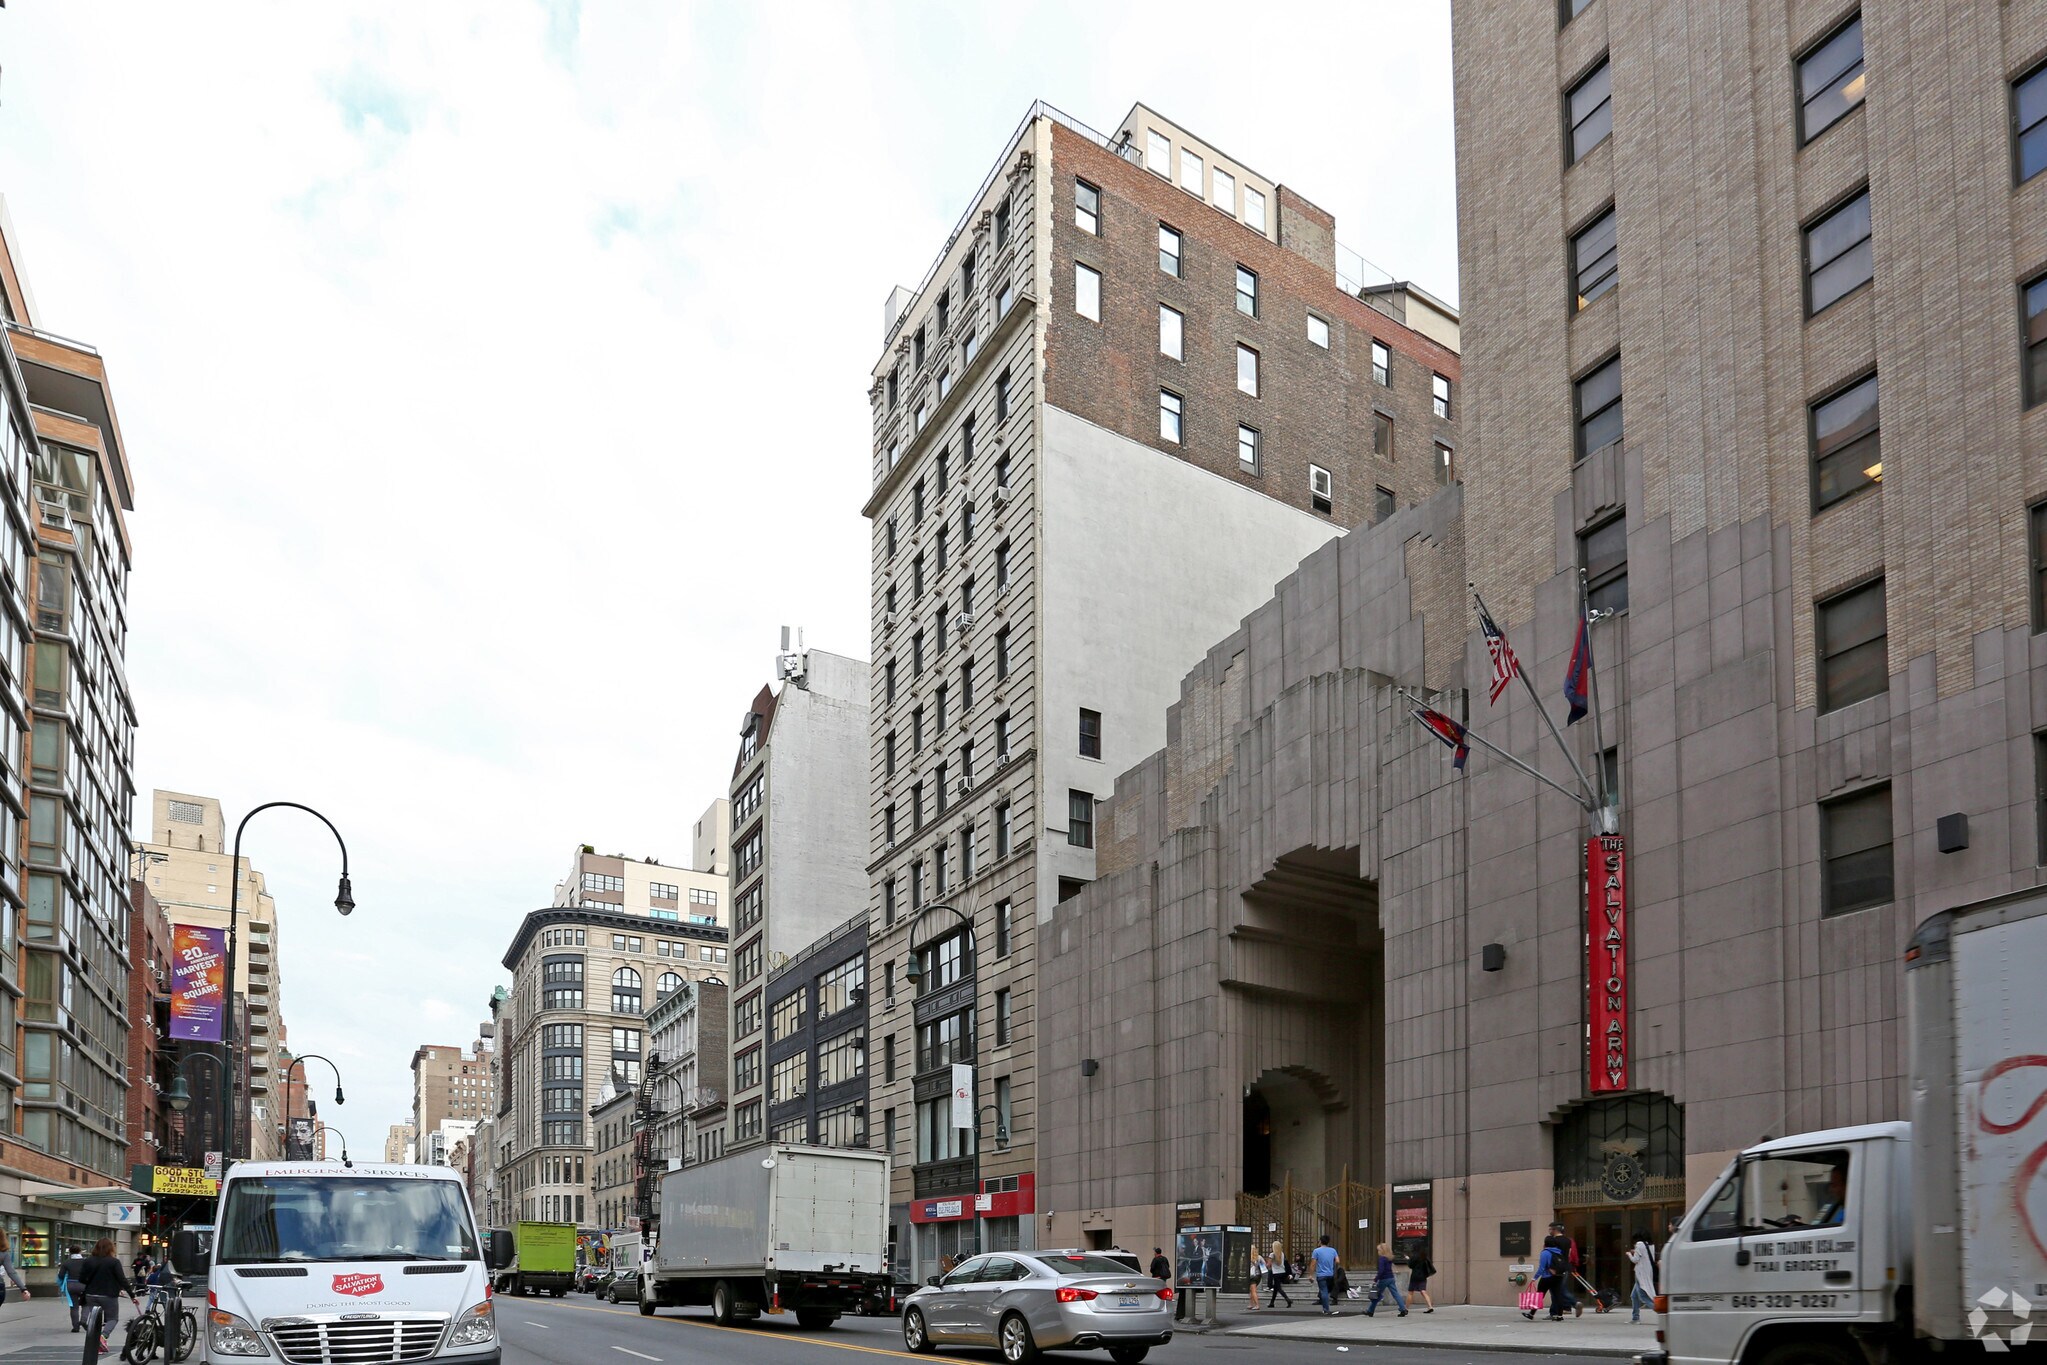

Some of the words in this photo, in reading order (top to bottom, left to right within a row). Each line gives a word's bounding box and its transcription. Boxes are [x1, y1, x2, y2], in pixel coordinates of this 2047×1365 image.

[1600, 838, 1624, 851] THE
[1605, 854, 1622, 1011] SALVATION
[182, 946, 203, 961] 20
[175, 959, 217, 977] HARVEST
[196, 970, 207, 979] IN
[189, 978, 209, 989] THE
[182, 984, 219, 1000] SQUARE
[1606, 1018, 1624, 1087] ARMY
[155, 1167, 182, 1176] GOOD
[187, 1169, 205, 1178] STU
[265, 1168, 358, 1176] EMERGENCY
[363, 1169, 429, 1178] SERVICES
[169, 1176, 203, 1184] DINER
[156, 1187, 214, 1195] 212-929-2555
[1754, 1242, 1773, 1256] KING
[1777, 1240, 1813, 1255] TRADING
[1753, 1261, 1779, 1272] THAI
[1785, 1259, 1840, 1271] GROCERY
[335, 1275, 378, 1291] SALVATION
[341, 1275, 361, 1283] THE
[351, 1282, 377, 1294] ARMY
[1731, 1294, 1838, 1308] 646-320-0297
